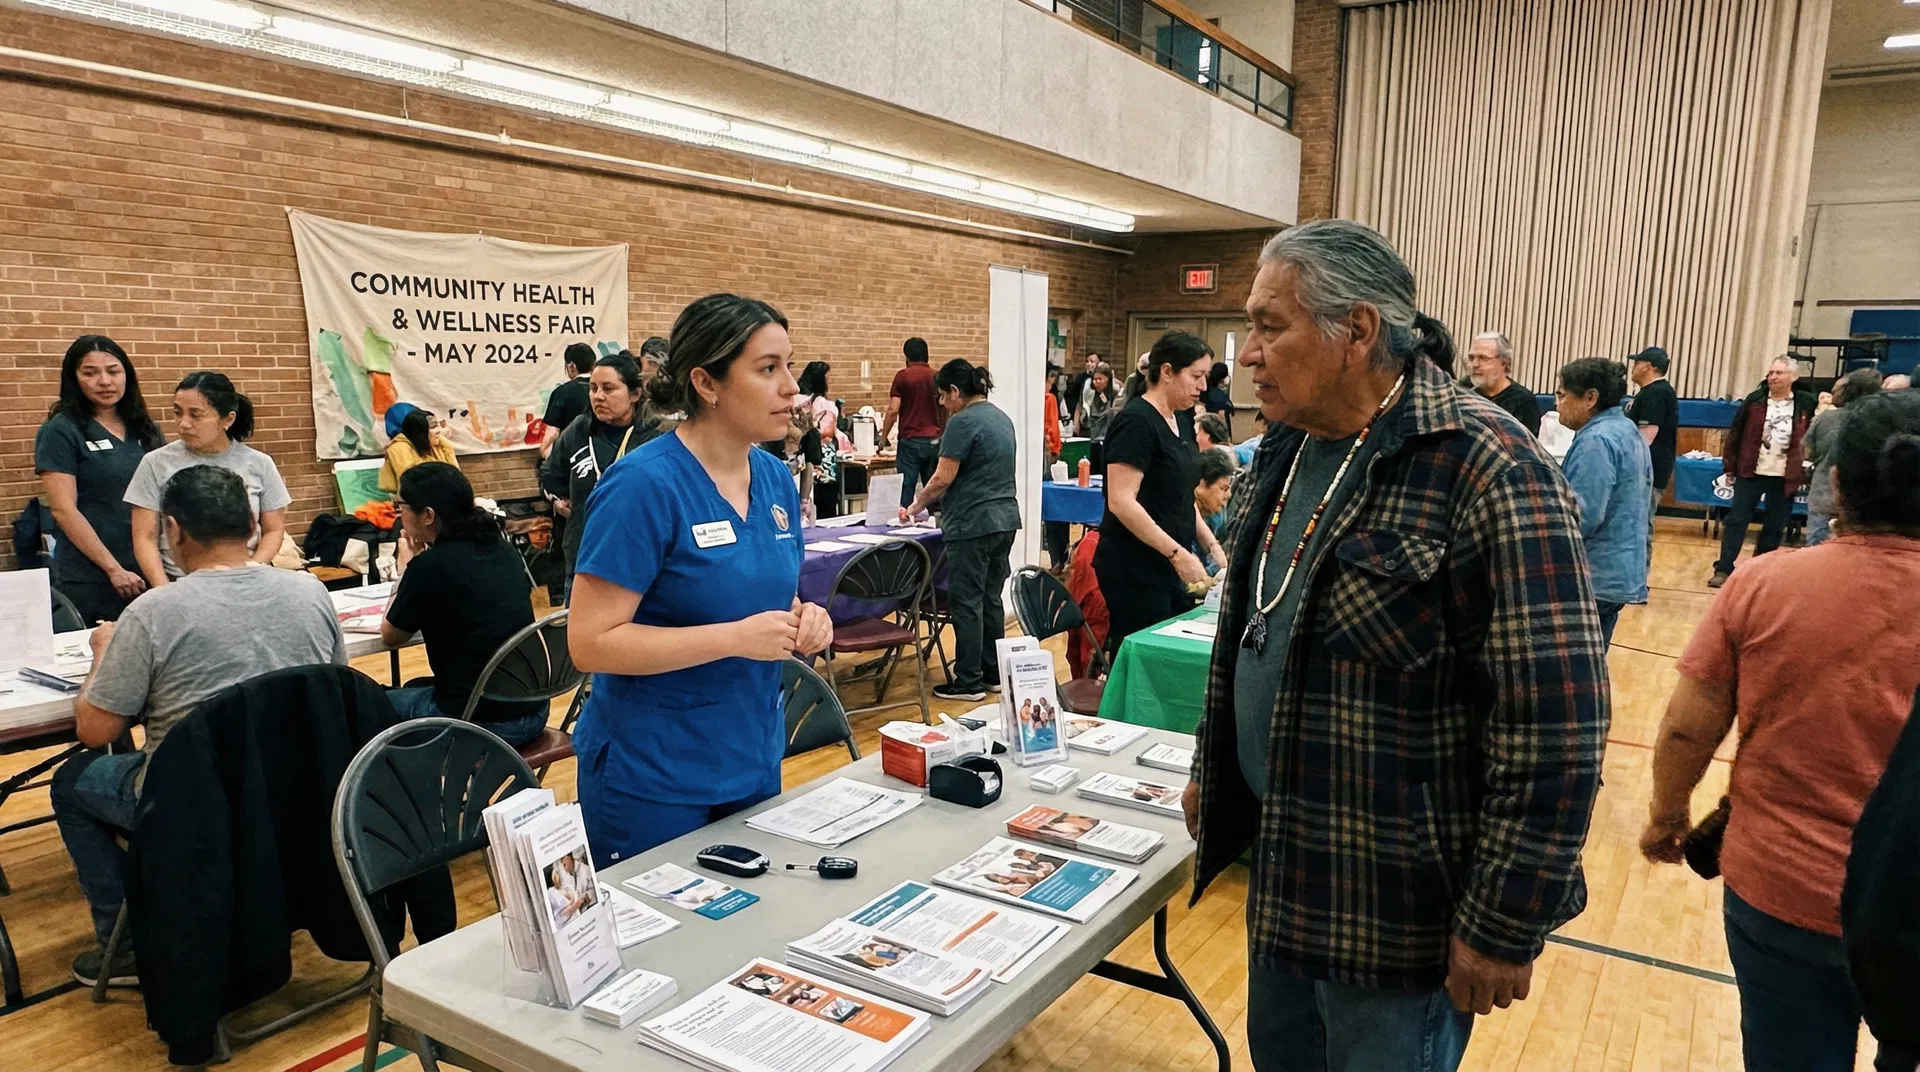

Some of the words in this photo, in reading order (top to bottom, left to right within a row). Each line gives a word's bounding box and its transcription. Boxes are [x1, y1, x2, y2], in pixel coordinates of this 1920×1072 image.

[350, 271, 506, 303] COMMUNITY
[512, 282, 595, 306] HEALTH
[392, 307, 409, 330] &
[415, 308, 541, 334] WELLNESS
[548, 314, 596, 335] FAIR
[424, 342, 477, 364] MAY
[484, 343, 539, 364] 2024
